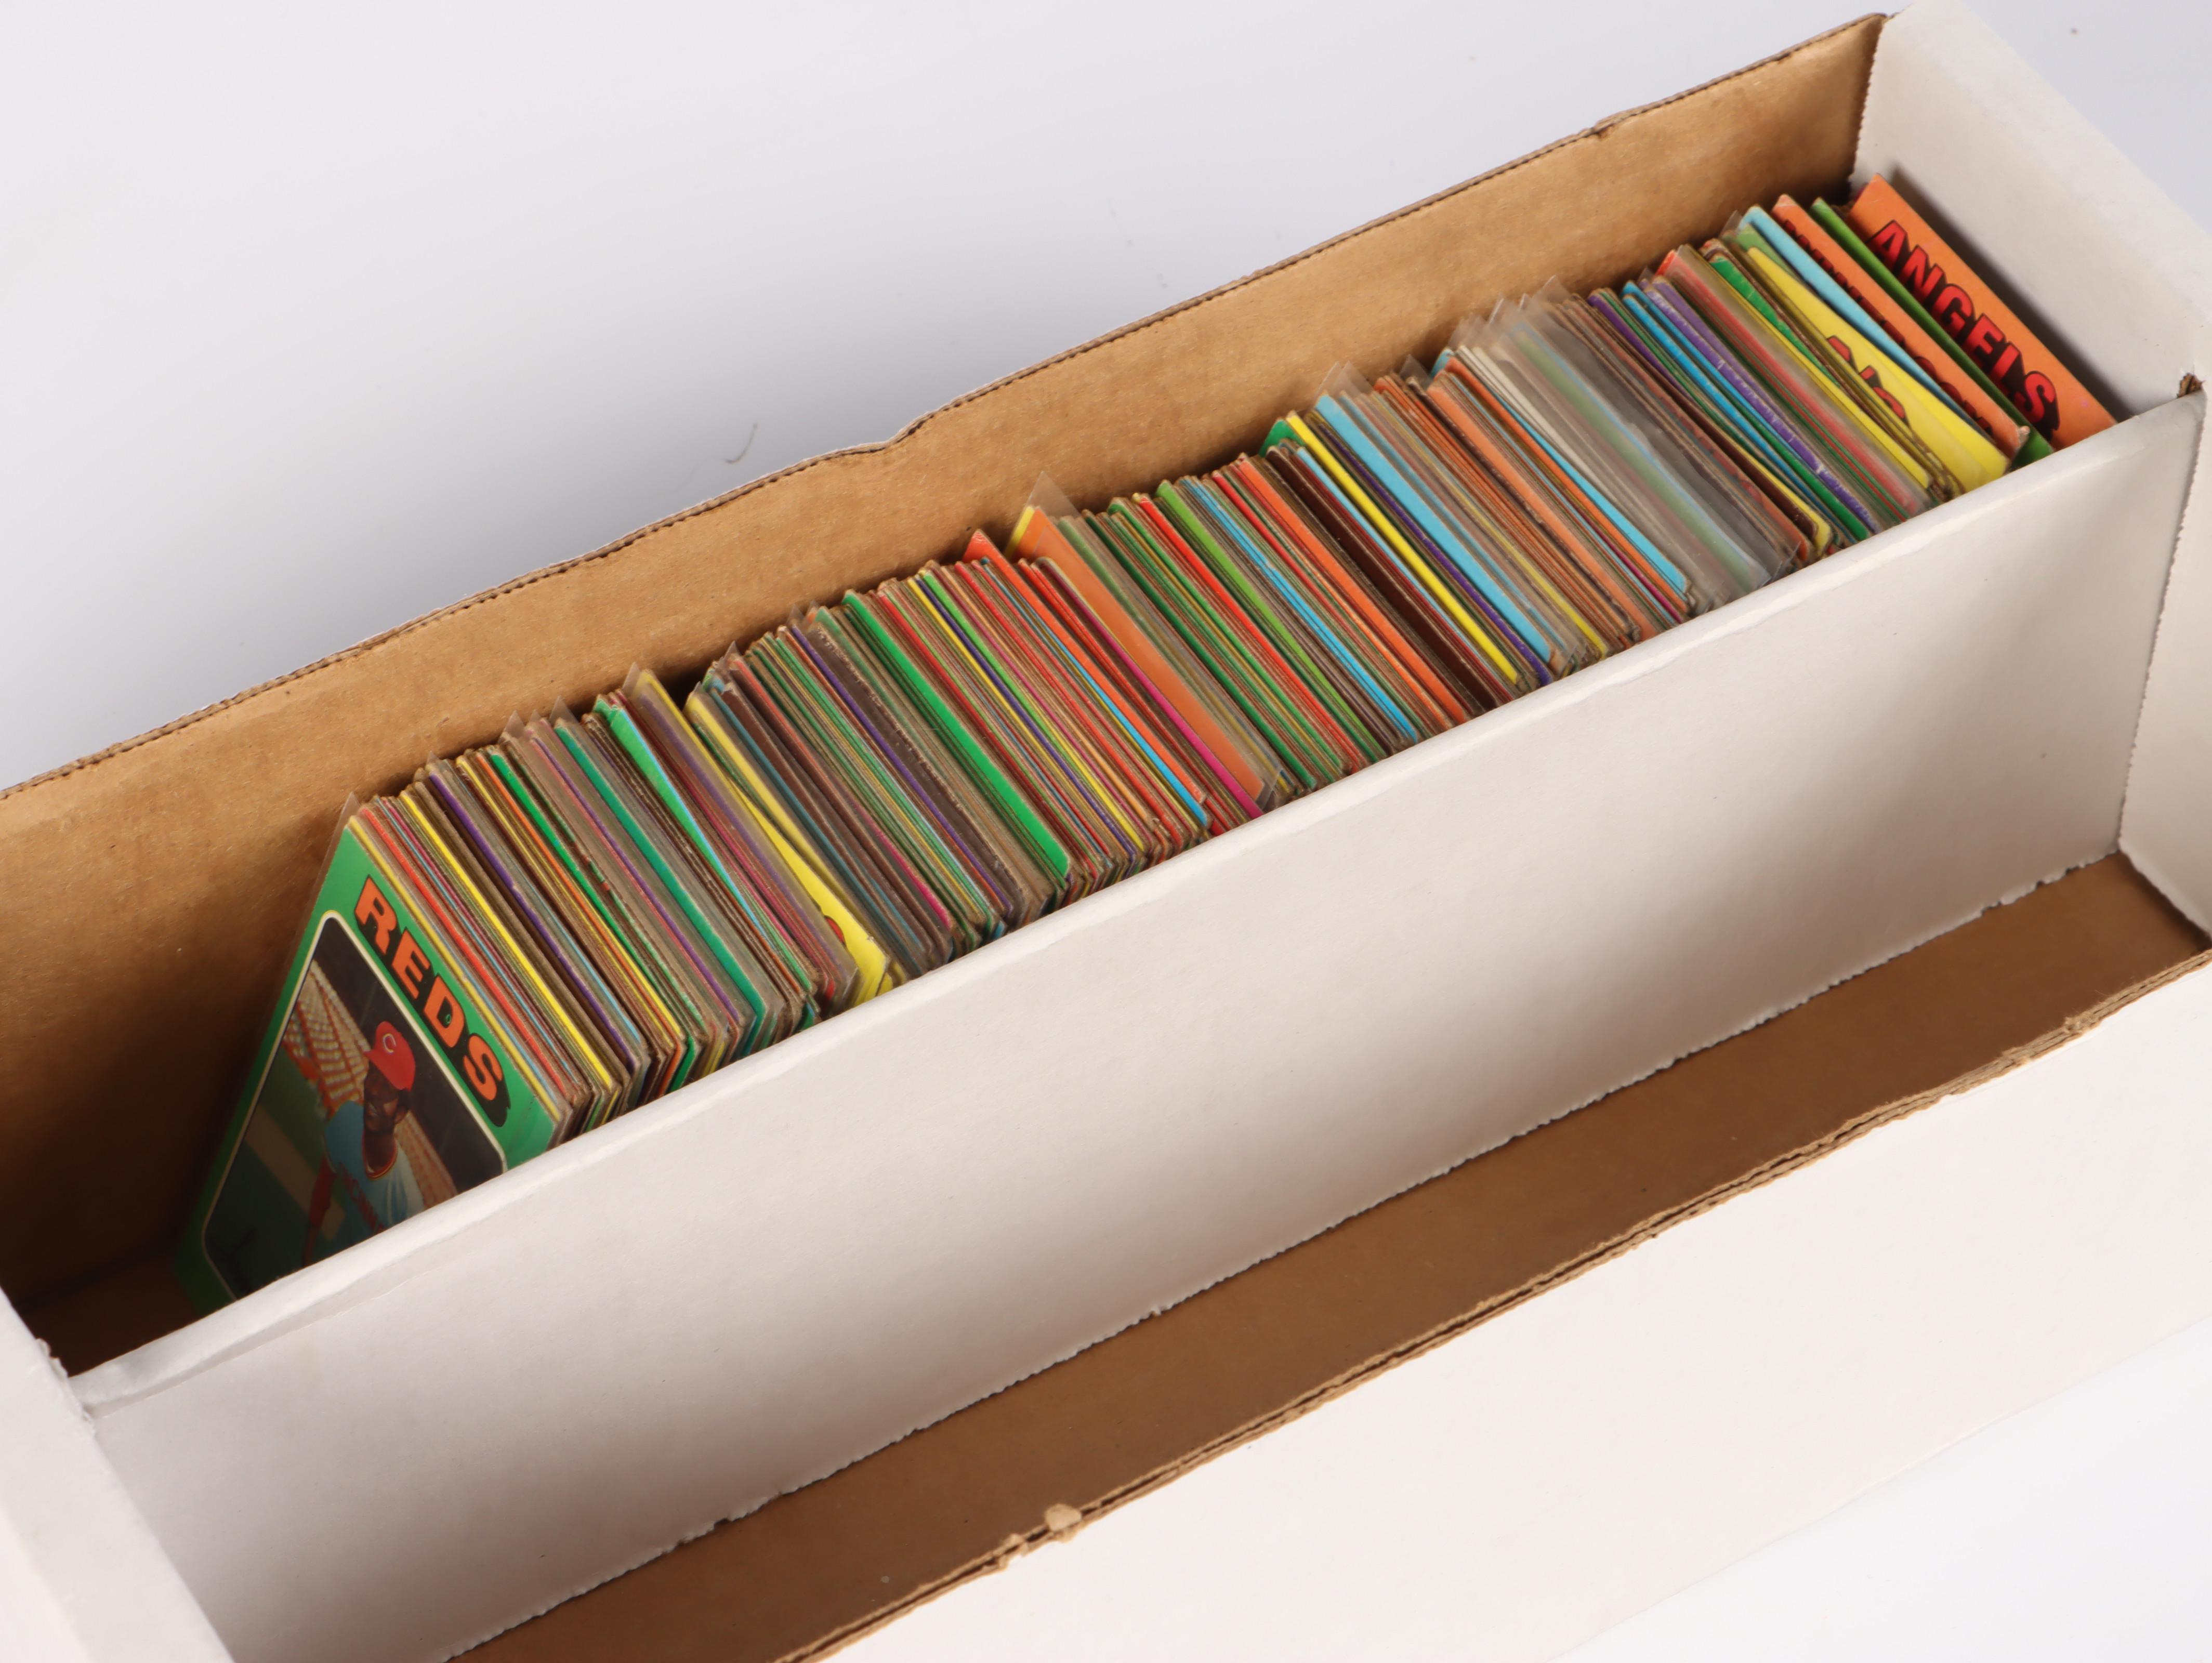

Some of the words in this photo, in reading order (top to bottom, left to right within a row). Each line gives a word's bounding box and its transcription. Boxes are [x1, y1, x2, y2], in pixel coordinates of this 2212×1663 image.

[1867, 219, 2059, 434] ANGELS
[354, 875, 507, 1117] REDS
[382, 1033, 397, 1053] C
